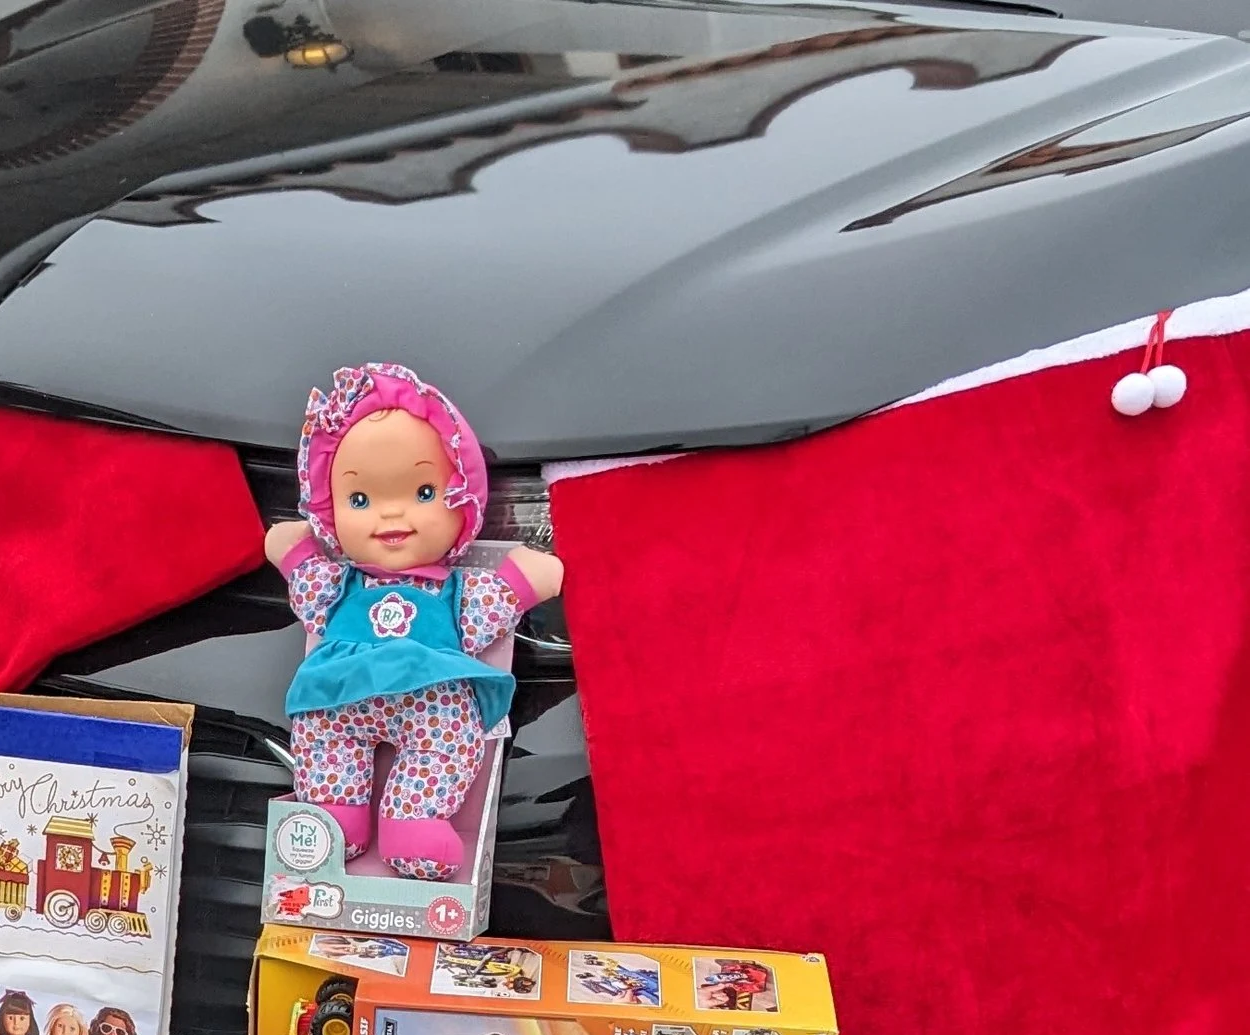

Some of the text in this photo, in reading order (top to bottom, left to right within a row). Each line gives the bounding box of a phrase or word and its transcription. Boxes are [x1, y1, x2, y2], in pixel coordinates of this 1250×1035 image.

[22, 773, 154, 815] Christmas
[292, 820, 317, 837] Try
[290, 833, 317, 847] Me!
[313, 888, 334, 908] First
[351, 909, 415, 929] Giggles
[435, 904, 459, 922] 1+
